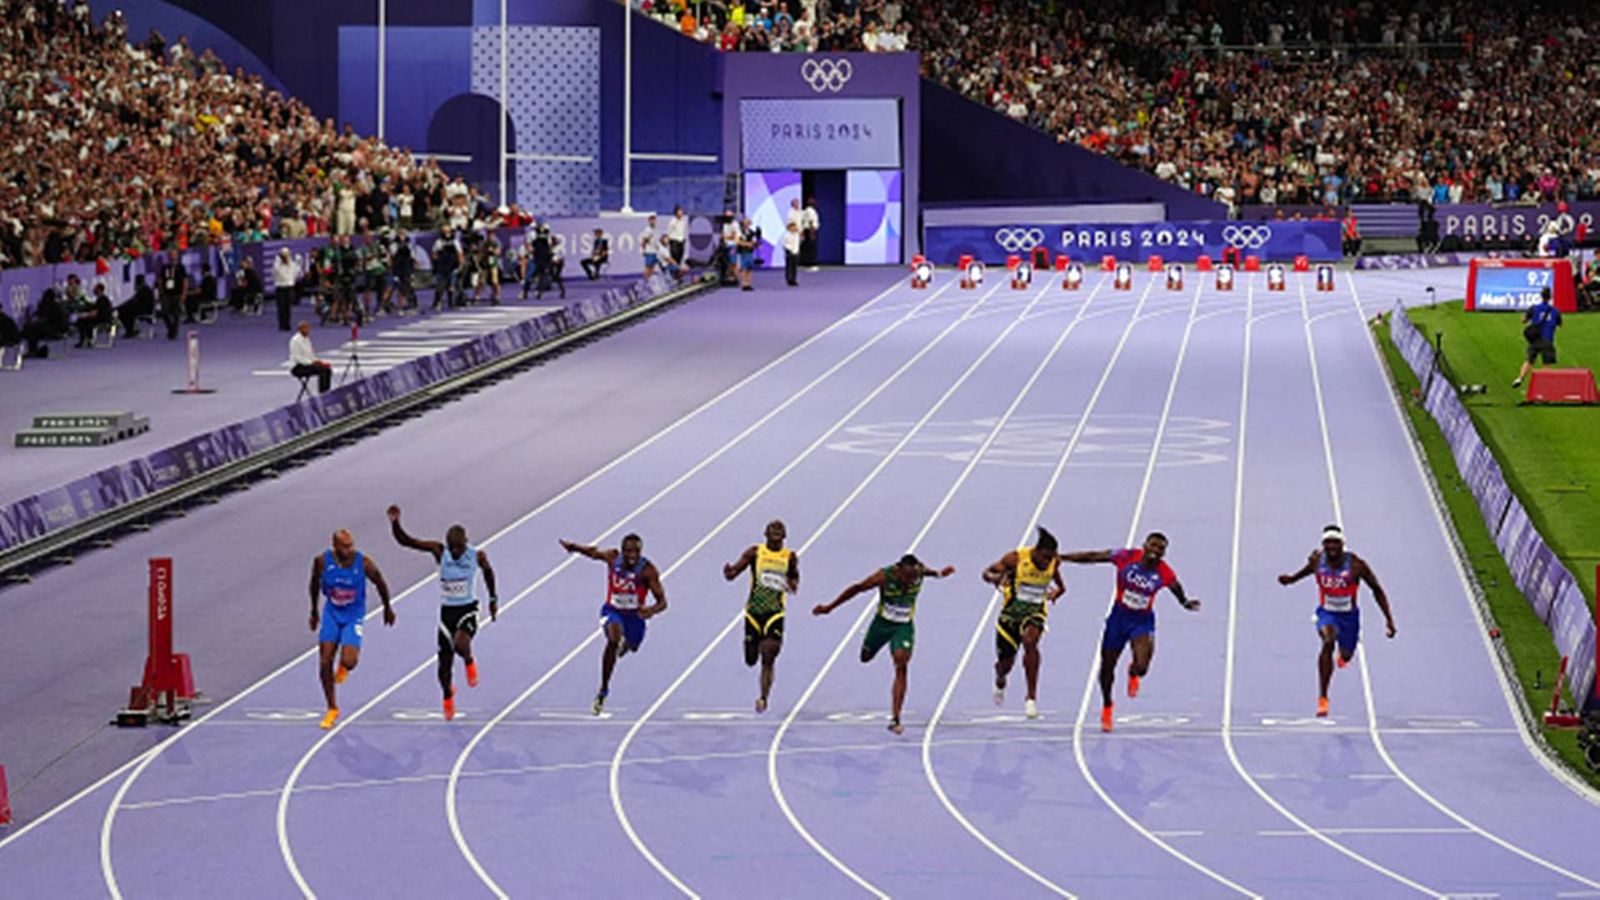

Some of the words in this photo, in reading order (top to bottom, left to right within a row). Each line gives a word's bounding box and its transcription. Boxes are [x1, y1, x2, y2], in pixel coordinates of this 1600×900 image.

[771, 123, 822, 140] PARIS
[826, 123, 873, 140] 2024
[1062, 230, 1132, 248] PARIS
[1140, 230, 1205, 247] 2024
